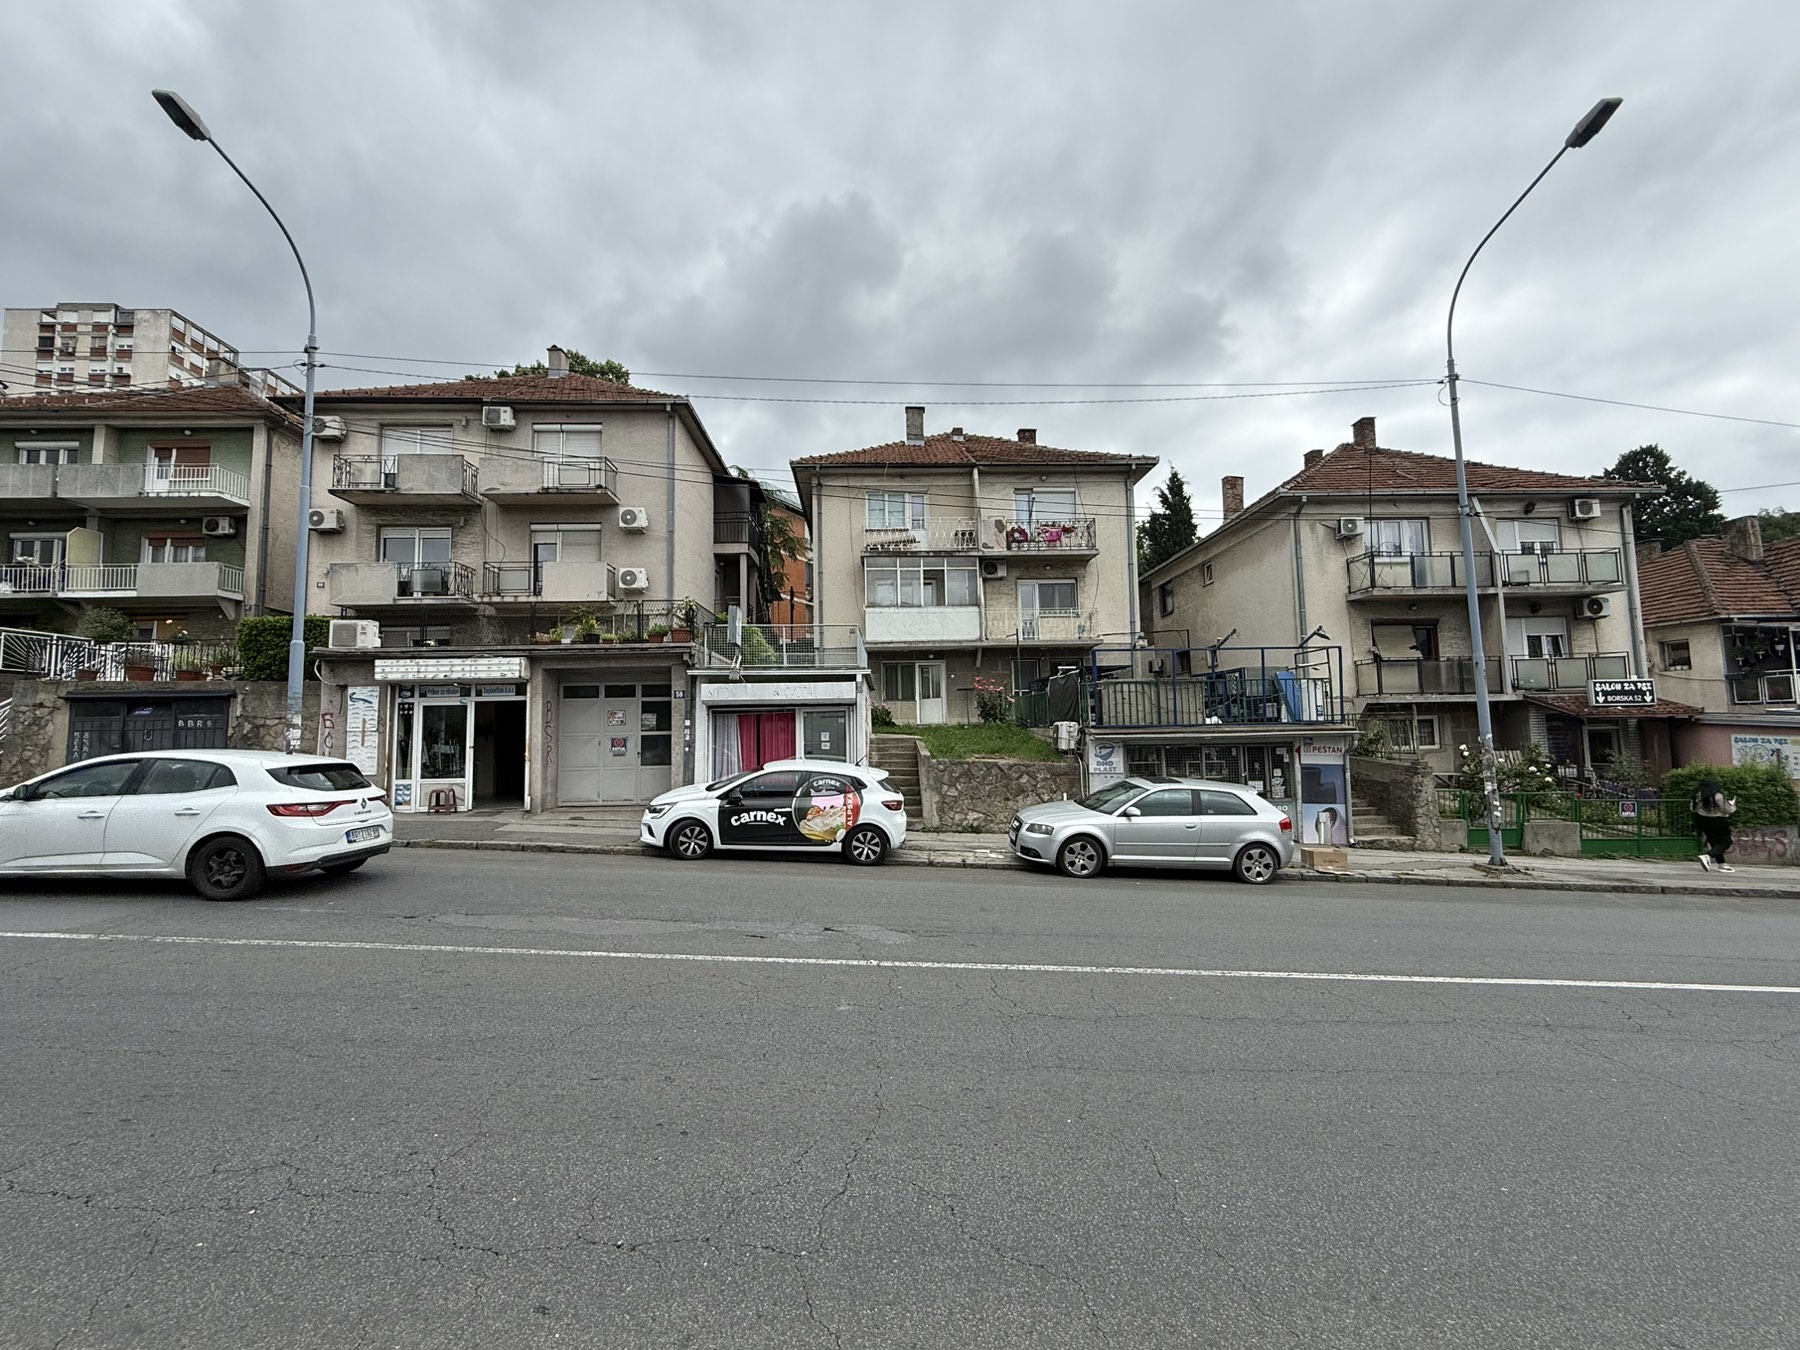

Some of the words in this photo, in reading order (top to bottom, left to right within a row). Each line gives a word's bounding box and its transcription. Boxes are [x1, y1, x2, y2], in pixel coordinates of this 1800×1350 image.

[1595, 683, 1621, 691] SALON
[1623, 683, 1635, 691] ZA
[1637, 682, 1652, 691] PSE
[675, 690, 683, 698] 58
[1312, 745, 1342, 753] PEŠTAN
[813, 779, 841, 787] carnex
[731, 810, 787, 826] carnex
